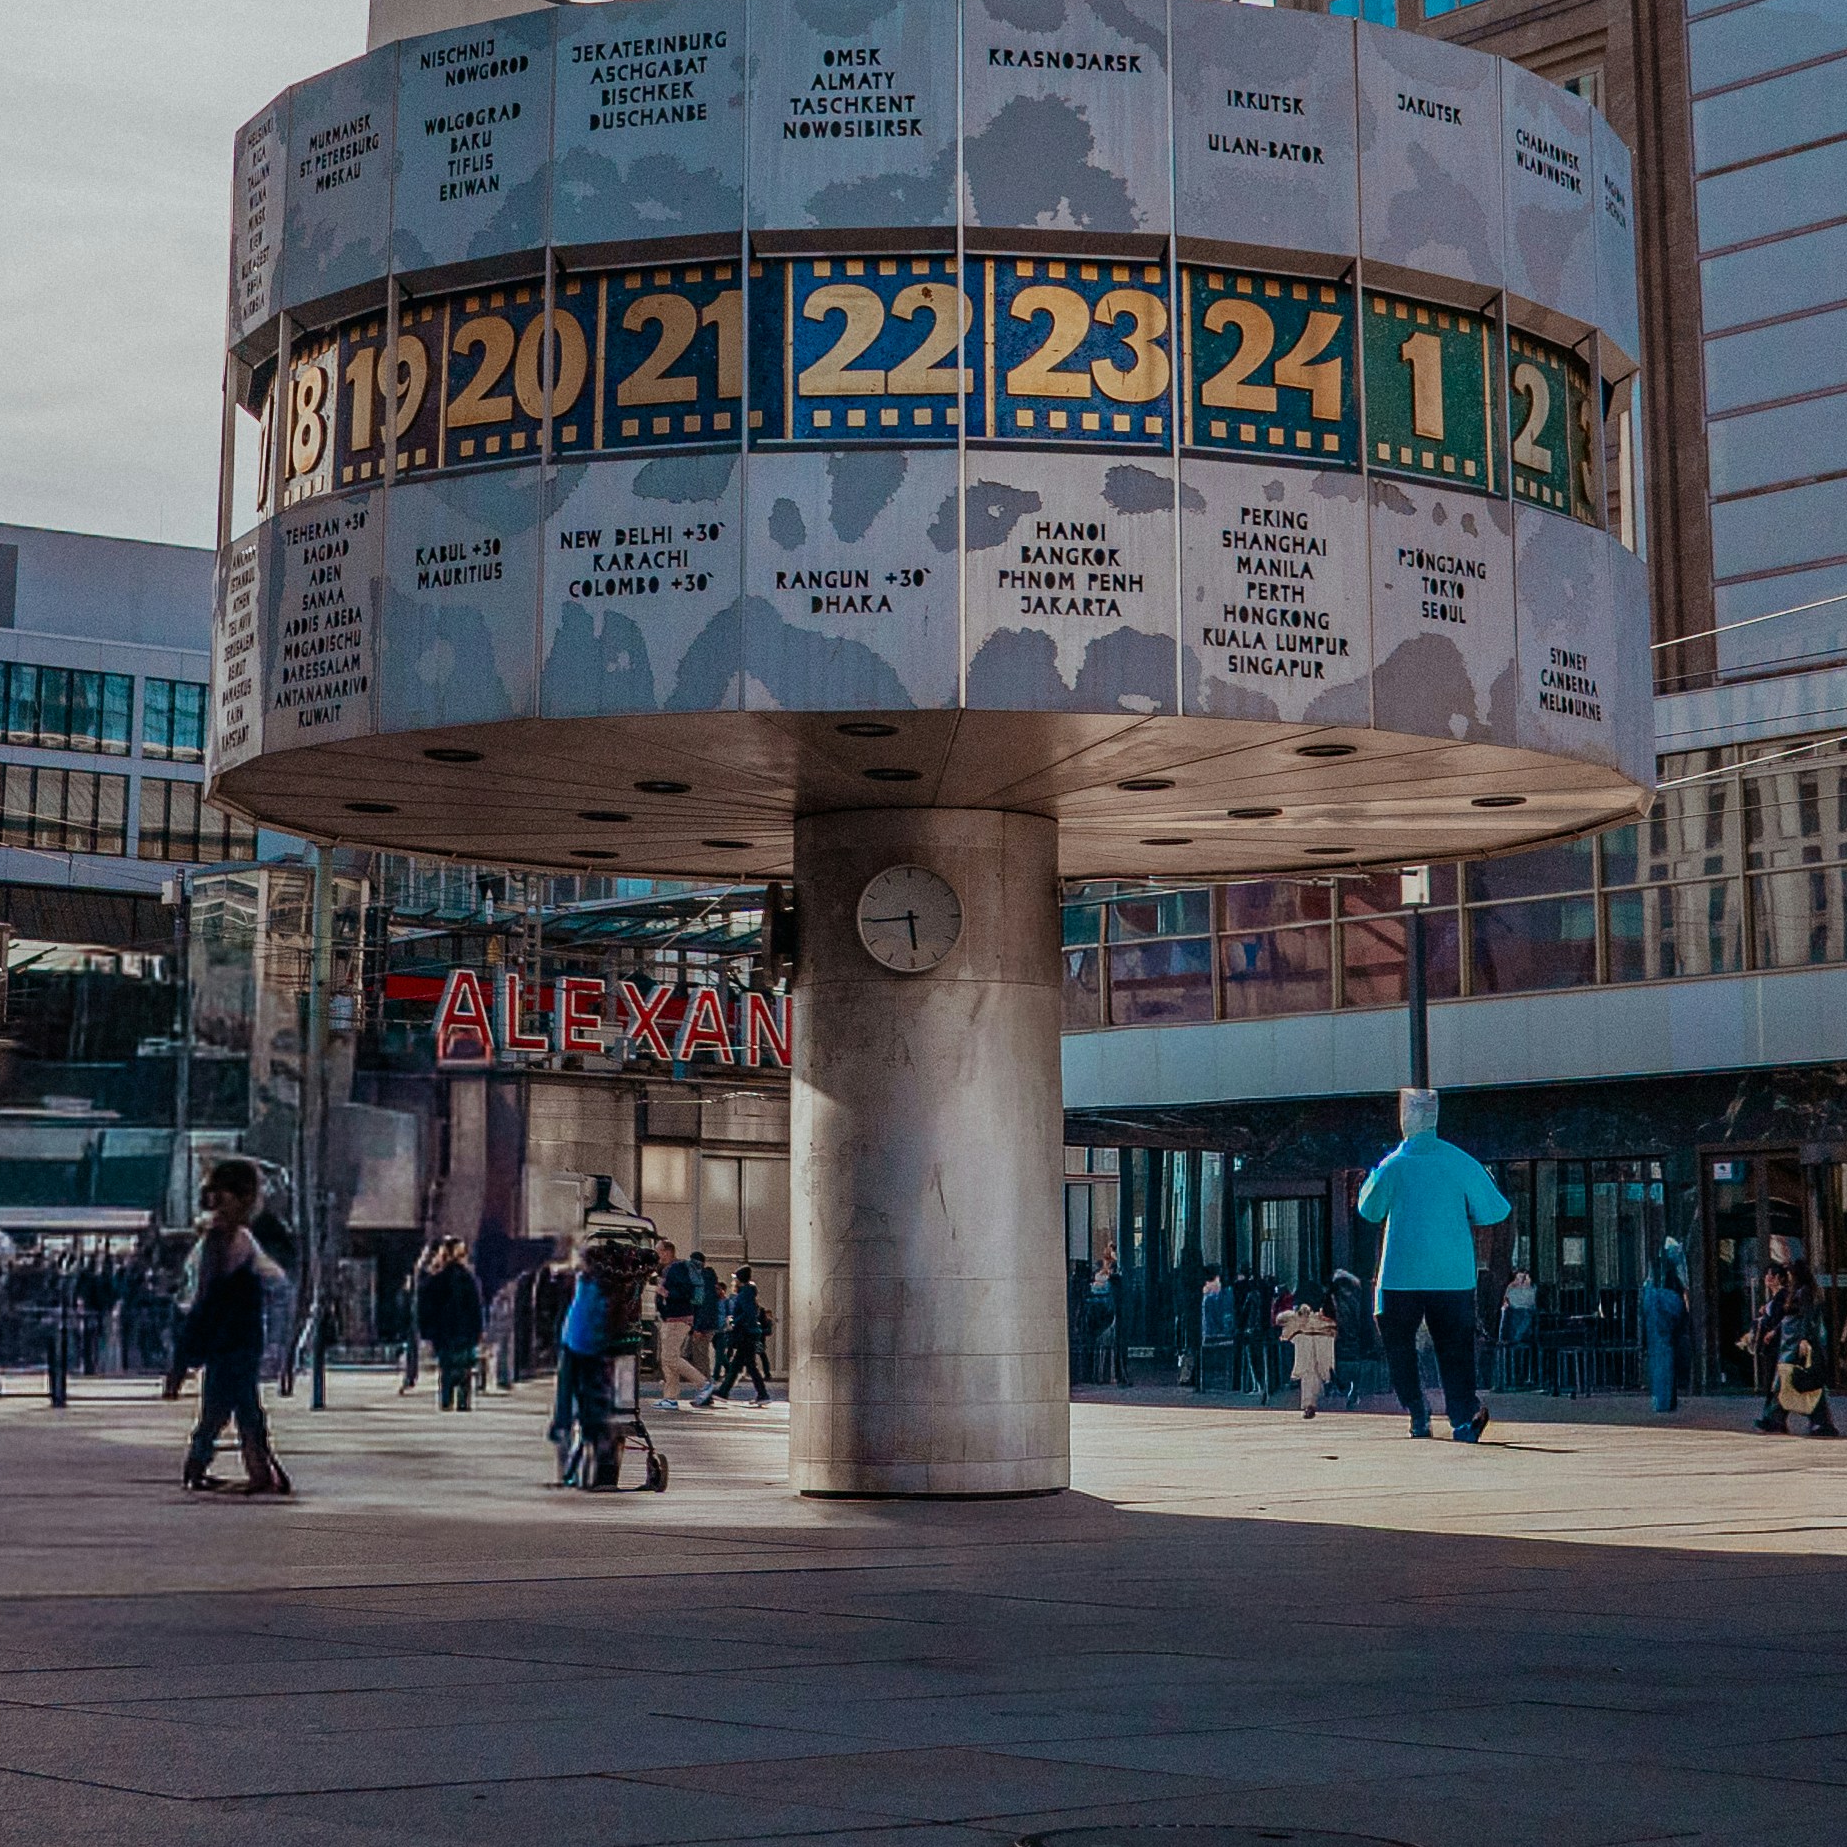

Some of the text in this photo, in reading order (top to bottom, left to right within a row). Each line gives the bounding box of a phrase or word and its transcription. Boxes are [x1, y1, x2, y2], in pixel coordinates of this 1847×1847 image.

[420, 39, 495, 71] NISCHNIJ
[572, 31, 727, 64] JEKATERINBURG
[823, 48, 882, 68] OMSK
[988, 48, 1142, 74] KRASNOJARSK
[445, 56, 529, 88] NOWGOROD
[591, 56, 708, 85] ASCHGABAT
[811, 71, 896, 92] ALMATY
[601, 81, 695, 107] BISCHKEK
[790, 95, 916, 116] TASCHKENT
[1227, 89, 1305, 116] IRKUTSK
[424, 102, 522, 136] WOLGOGRAD
[589, 103, 708, 131] DUSCHANBE
[1397, 93, 1463, 126] JAKUTSK
[309, 114, 372, 150] MURMANSK
[450, 130, 492, 154] BAKU
[783, 118, 923, 140] NOWOSIBIRSK
[314, 133, 380, 166] PETERSBURG
[1208, 133, 1325, 165] ULAN-BATOR
[1515, 128, 1580, 172] CHABAROWSK
[316, 162, 361, 194] MOSKAU
[448, 153, 494, 177] TIFLIS
[1516, 149, 1582, 195] WLADIWOSTOK
[439, 174, 500, 202] ERIWAN
[617, 289, 743, 407] 21
[798, 283, 974, 396] 22
[1006, 284, 1171, 403] 23
[447, 308, 588, 429] 20
[1201, 298, 1343, 422] 24
[345, 335, 428, 453] 19
[1402, 331, 1445, 440] 1
[1513, 362, 1552, 473] 2
[286, 517, 340, 545] TEHERAN
[1036, 521, 1106, 542] HANOI
[1241, 506, 1309, 531] PEKING
[560, 529, 602, 550] NEW
[615, 524, 673, 546] DELHI
[1222, 529, 1327, 557] SHANGHAI
[303, 538, 350, 566] BAGDAD
[416, 537, 502, 567] KABUL +30
[593, 549, 689, 572] KARACHI
[1021, 544, 1122, 568] BANGKOK
[1398, 547, 1487, 581] PJÖNGJANG
[309, 564, 342, 587] ADEN
[417, 561, 503, 590] MAURITIUS
[775, 569, 869, 590] RANGUN
[998, 569, 1144, 594] PHNOM PENH
[1236, 554, 1314, 581] MANILA
[302, 587, 345, 611] SANAA
[569, 575, 660, 598] COLOMBO
[1246, 580, 1305, 604] PERTH
[1421, 575, 1465, 600] TOKYO
[811, 593, 893, 614] DHAKA
[1020, 595, 1122, 618] JAKARTA
[1223, 603, 1330, 631] HONGKONG
[1421, 600, 1467, 625] SEOUL
[284, 605, 363, 638] ADDIS ABEBA
[284, 629, 362, 662] MOGADISCHU
[1202, 627, 1350, 657] KUALA LUMPUR
[282, 654, 361, 685] DARESSALAM
[1227, 653, 1326, 681] SINGAPUR
[1550, 646, 1589, 674] SYDNEY
[274, 675, 368, 709] ANTANANARIVO
[1540, 668, 1599, 700] CANBERRA
[298, 704, 342, 729] KUWAIT
[1539, 690, 1602, 723] MELBOURNE
